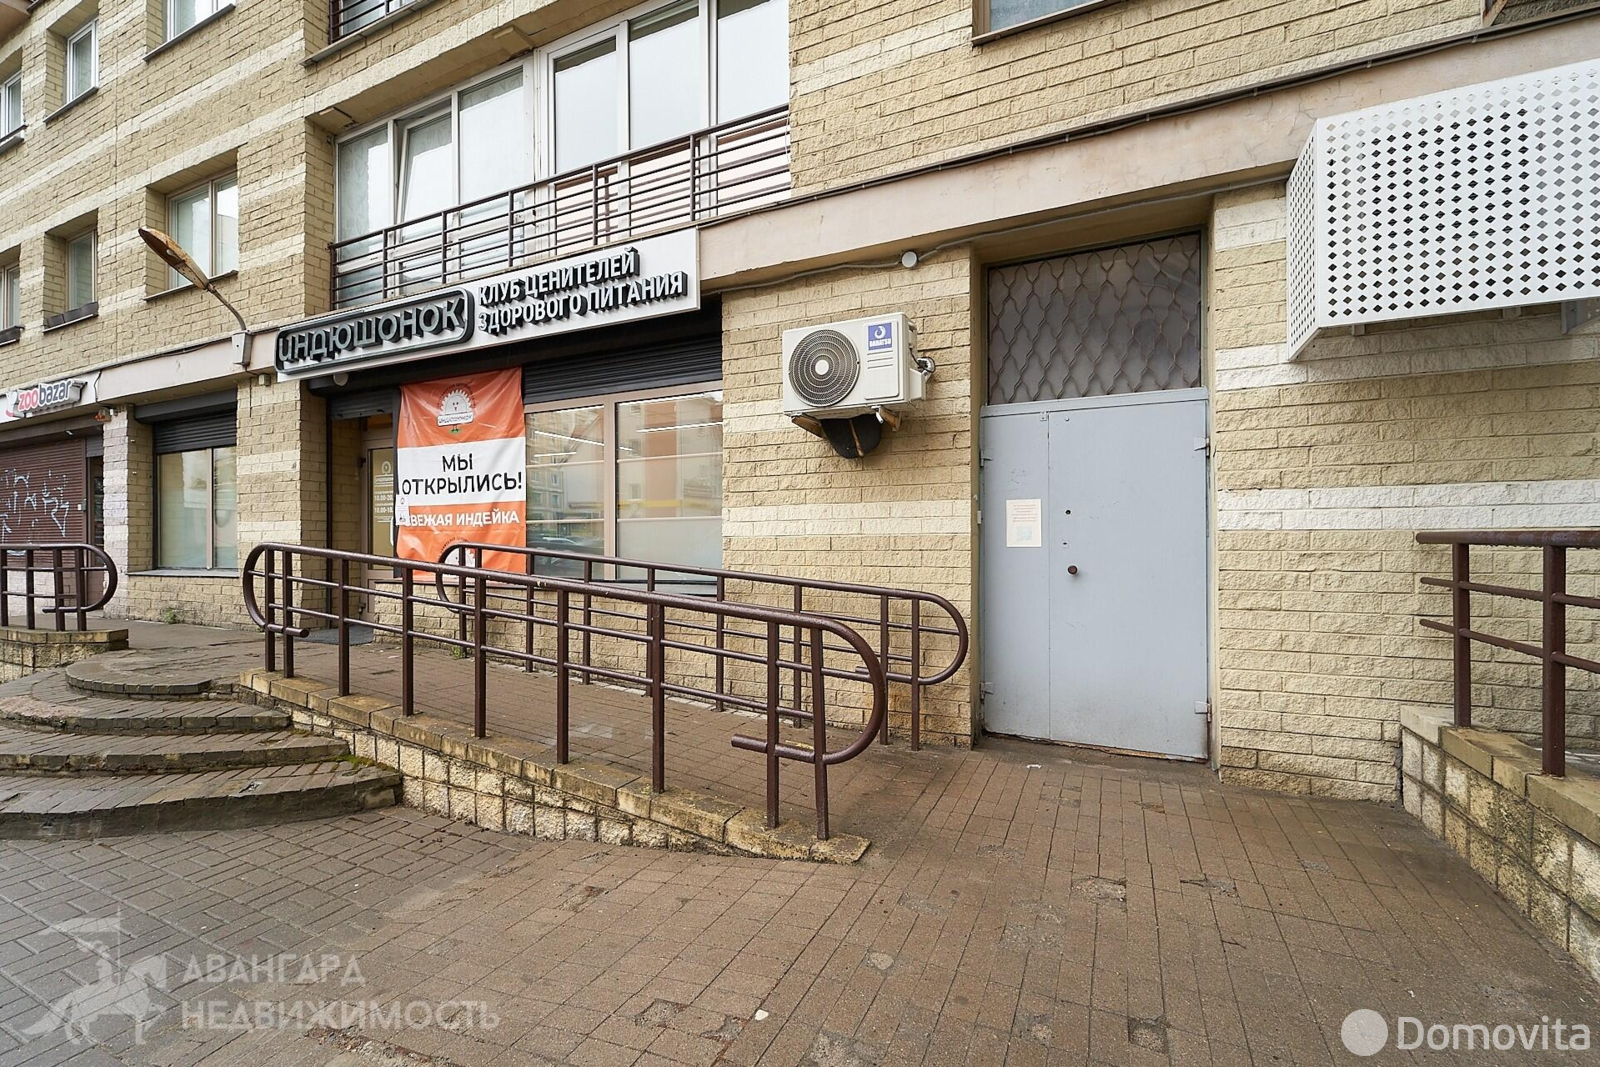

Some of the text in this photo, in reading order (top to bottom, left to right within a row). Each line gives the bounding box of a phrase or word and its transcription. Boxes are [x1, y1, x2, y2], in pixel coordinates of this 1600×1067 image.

[478, 247, 639, 306] КЛУБ ЦЕНИТЕЛЕЙ
[478, 271, 686, 333] ЗДОРОВОГО ПИТАНИЯ
[18, 379, 72, 412] zoobazar
[442, 453, 473, 472] МЫ
[402, 472, 522, 495] ОТКРЫЛИСЬ!
[456, 509, 520, 528] ИНДЕЙКА
